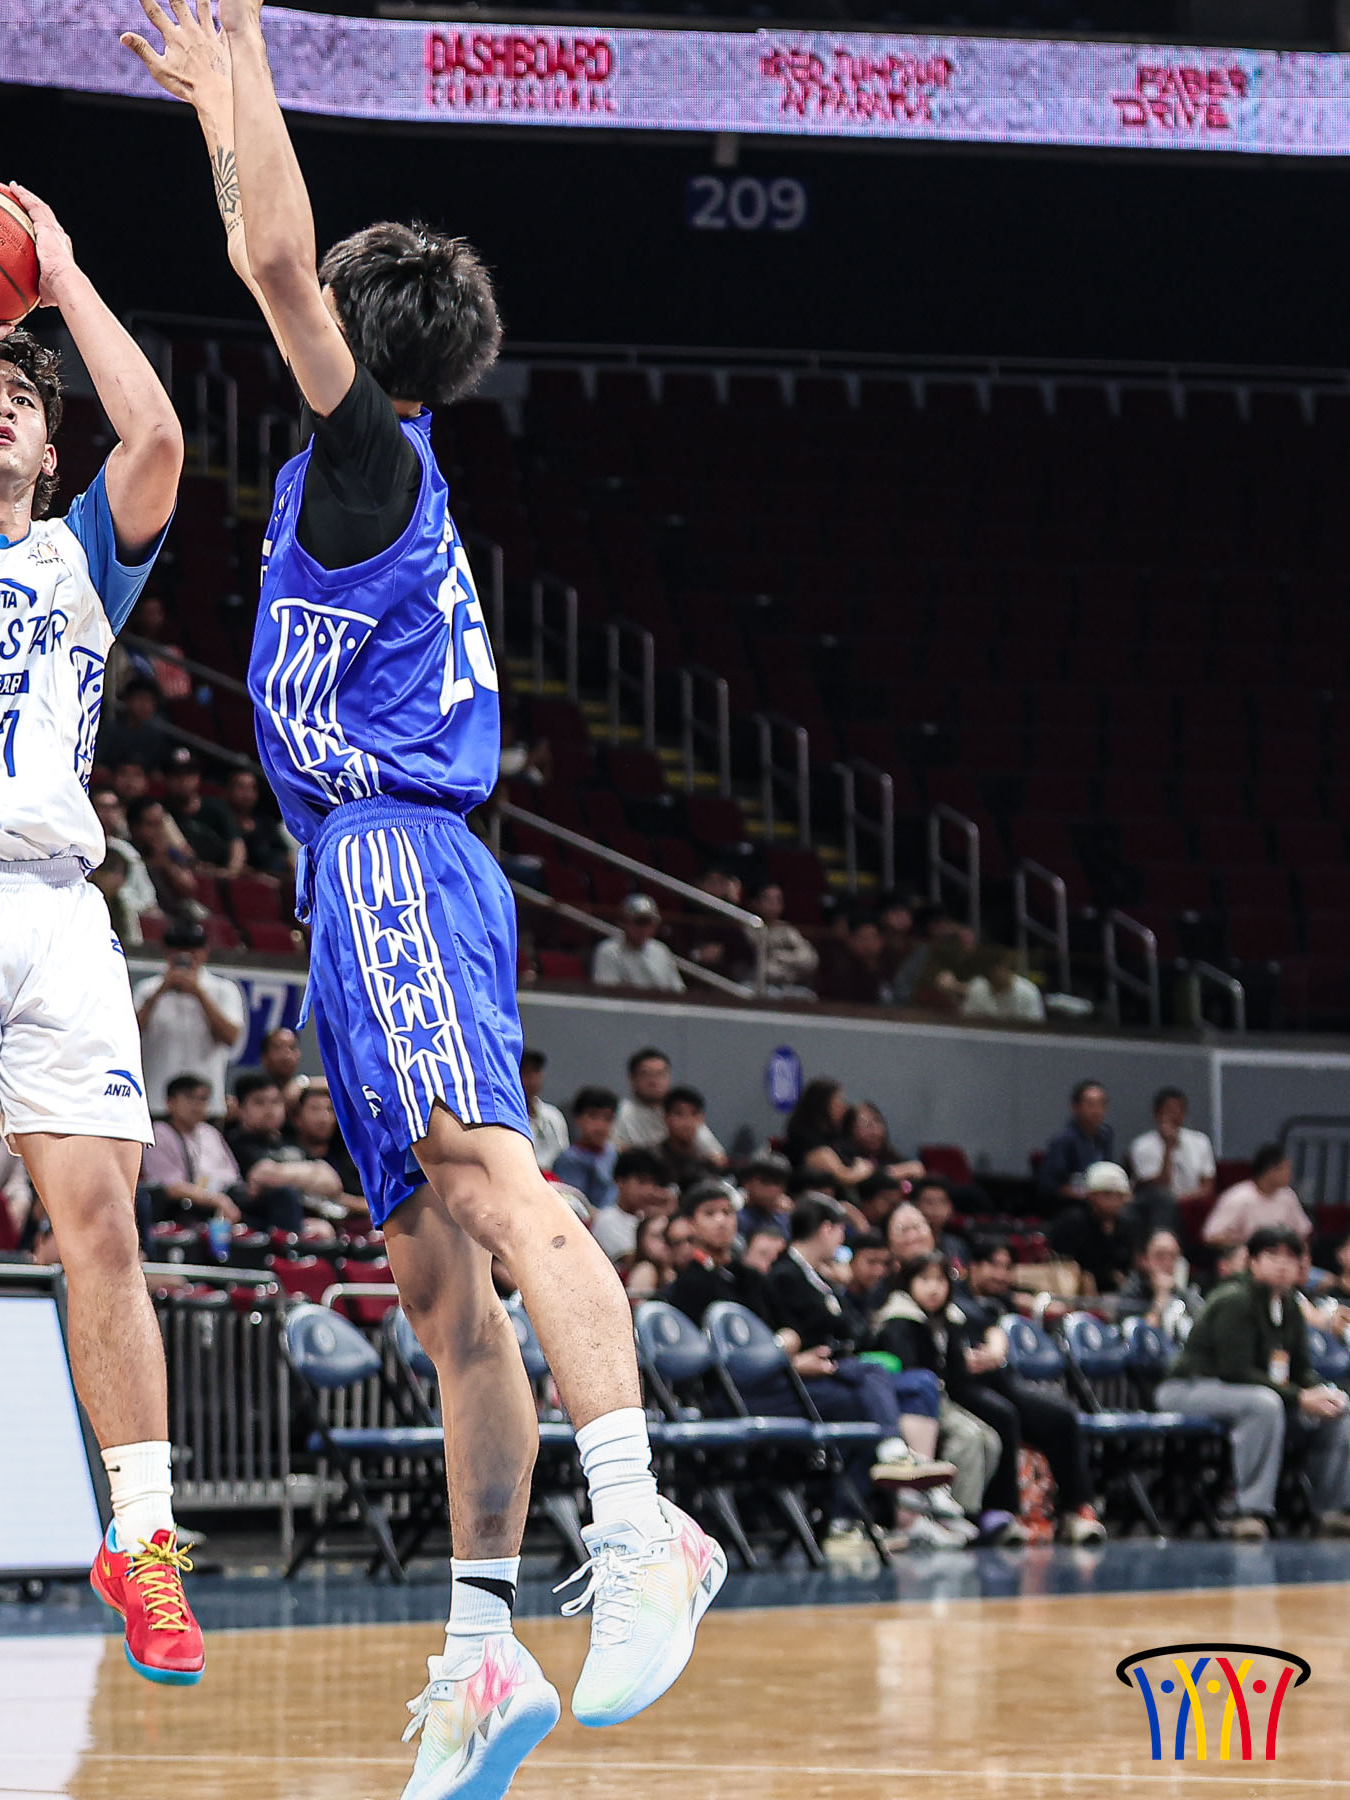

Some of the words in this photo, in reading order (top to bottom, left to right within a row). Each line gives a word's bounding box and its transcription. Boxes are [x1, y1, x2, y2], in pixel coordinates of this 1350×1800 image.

[424, 31, 614, 82] DASHBOARD
[692, 176, 807, 230] 209
[104, 1083, 131, 1098] ANTA
